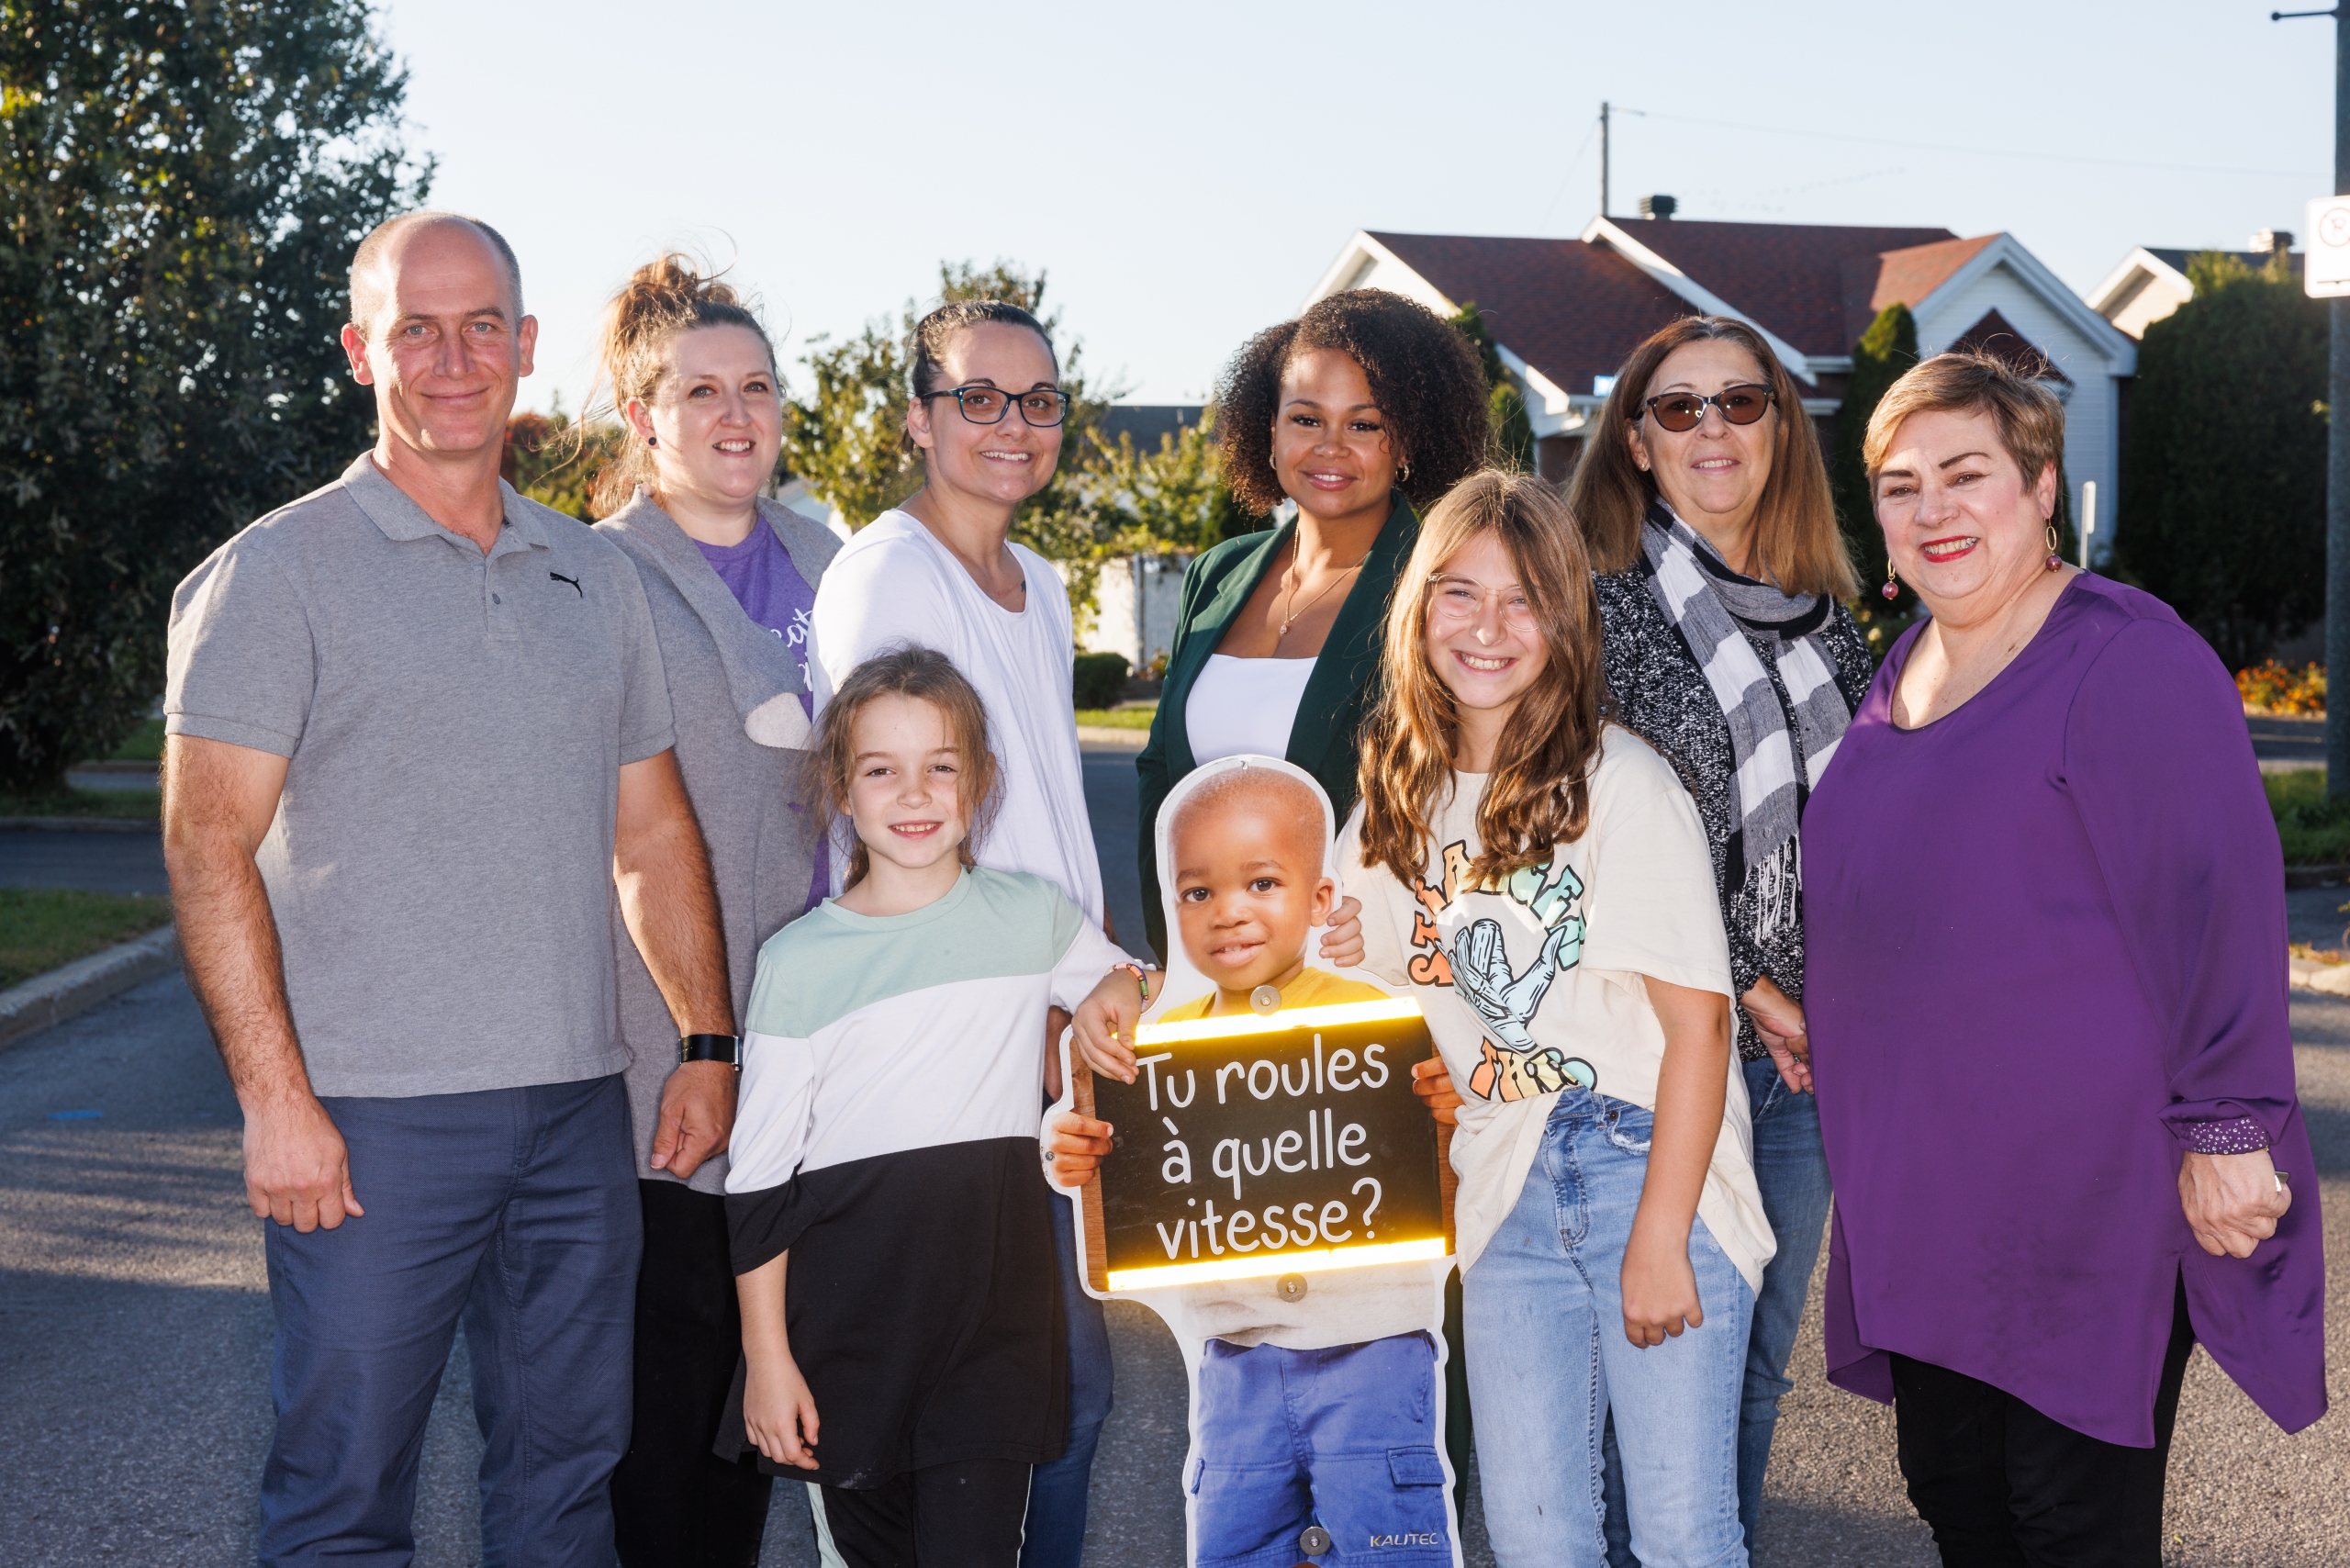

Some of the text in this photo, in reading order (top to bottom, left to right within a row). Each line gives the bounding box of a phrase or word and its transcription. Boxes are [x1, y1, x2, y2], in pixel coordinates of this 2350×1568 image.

[1135, 1033, 1390, 1111] Tu roules
[1161, 1107, 1371, 1201] à quelle
[1156, 1176, 1382, 1260] vitesse?
[1370, 1532, 1438, 1548] KALITEC
